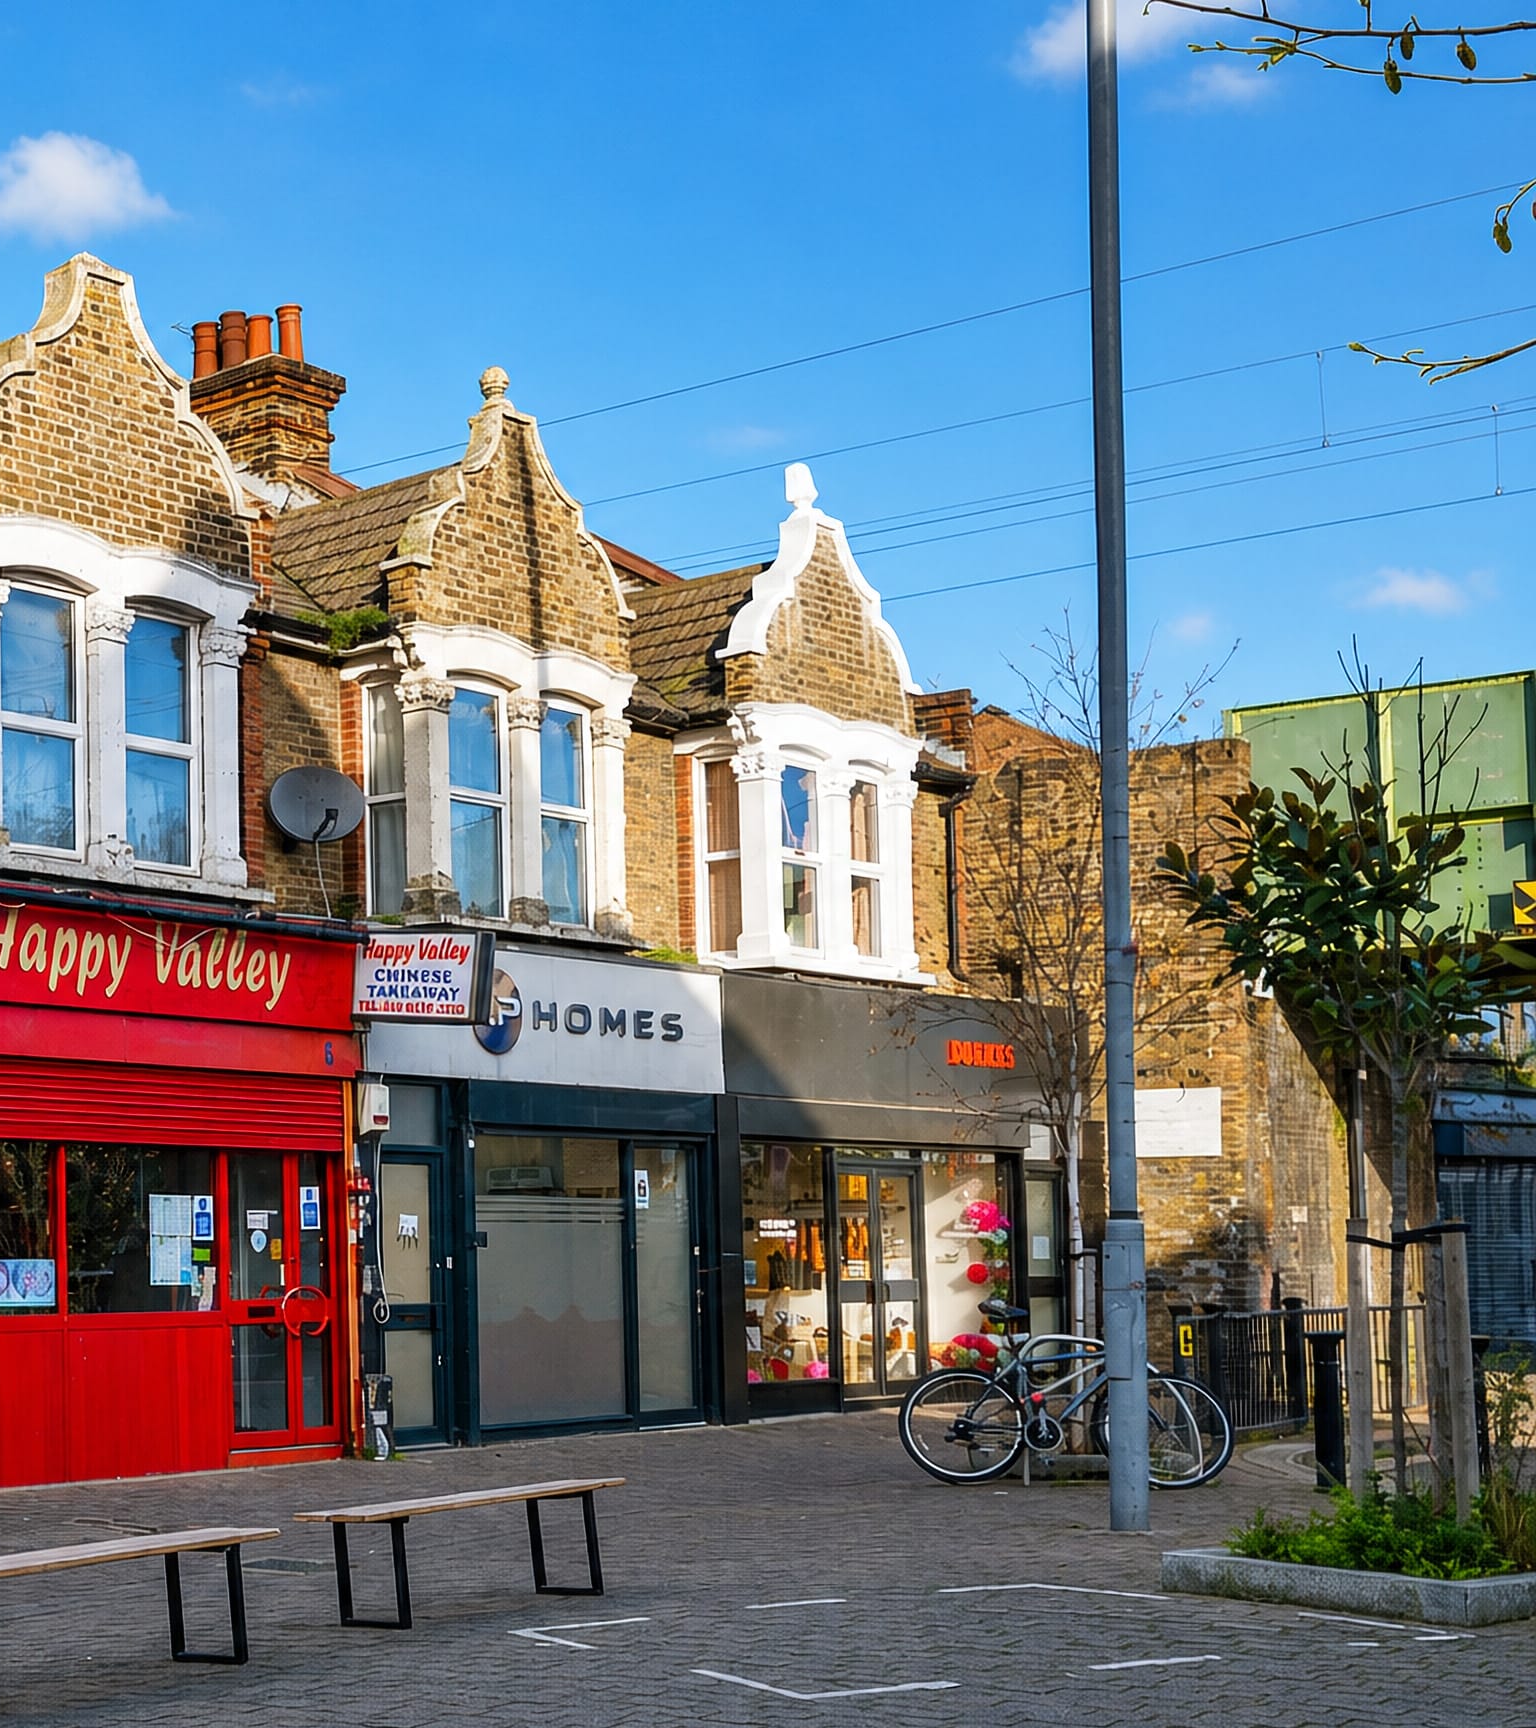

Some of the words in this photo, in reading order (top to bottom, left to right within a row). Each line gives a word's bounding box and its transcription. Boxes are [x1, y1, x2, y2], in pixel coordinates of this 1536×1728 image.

[154, 920, 291, 1011] Valley
[364, 938, 415, 967] Happy
[418, 937, 470, 965] Valley
[532, 1000, 684, 1042] HOMES
[324, 1041, 334, 1066] 6
